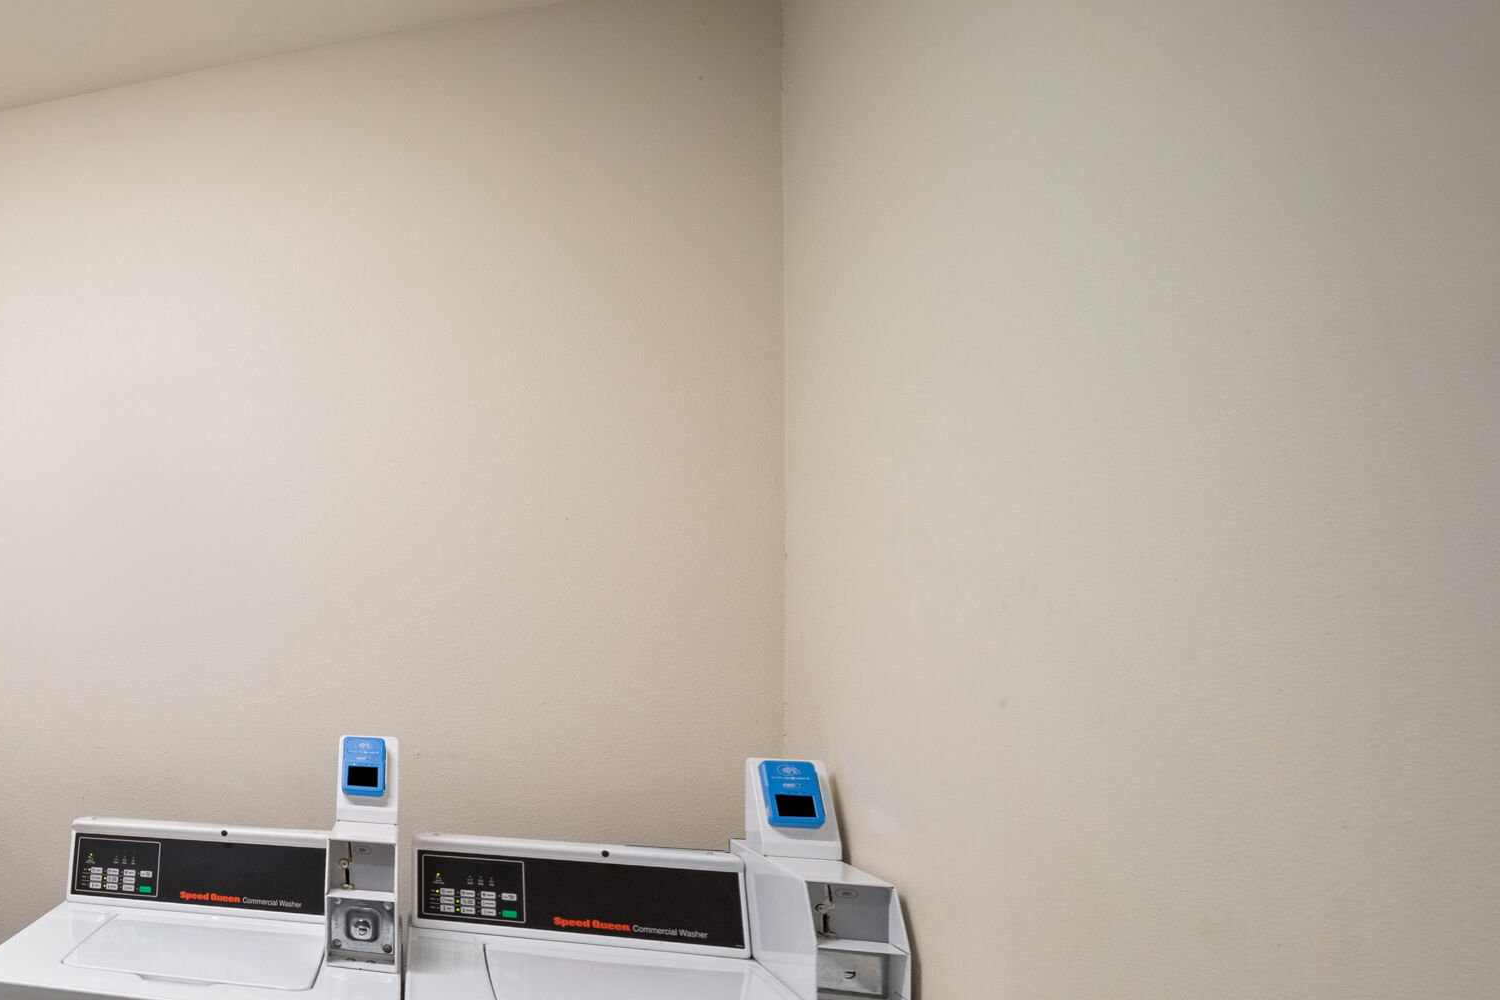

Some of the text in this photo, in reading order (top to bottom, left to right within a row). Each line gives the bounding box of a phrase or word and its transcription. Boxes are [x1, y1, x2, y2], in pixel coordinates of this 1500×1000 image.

[179, 890, 302, 909] Speed Queen Commercial Washer
[553, 916, 708, 939] Speed Queen Commercial Washer
